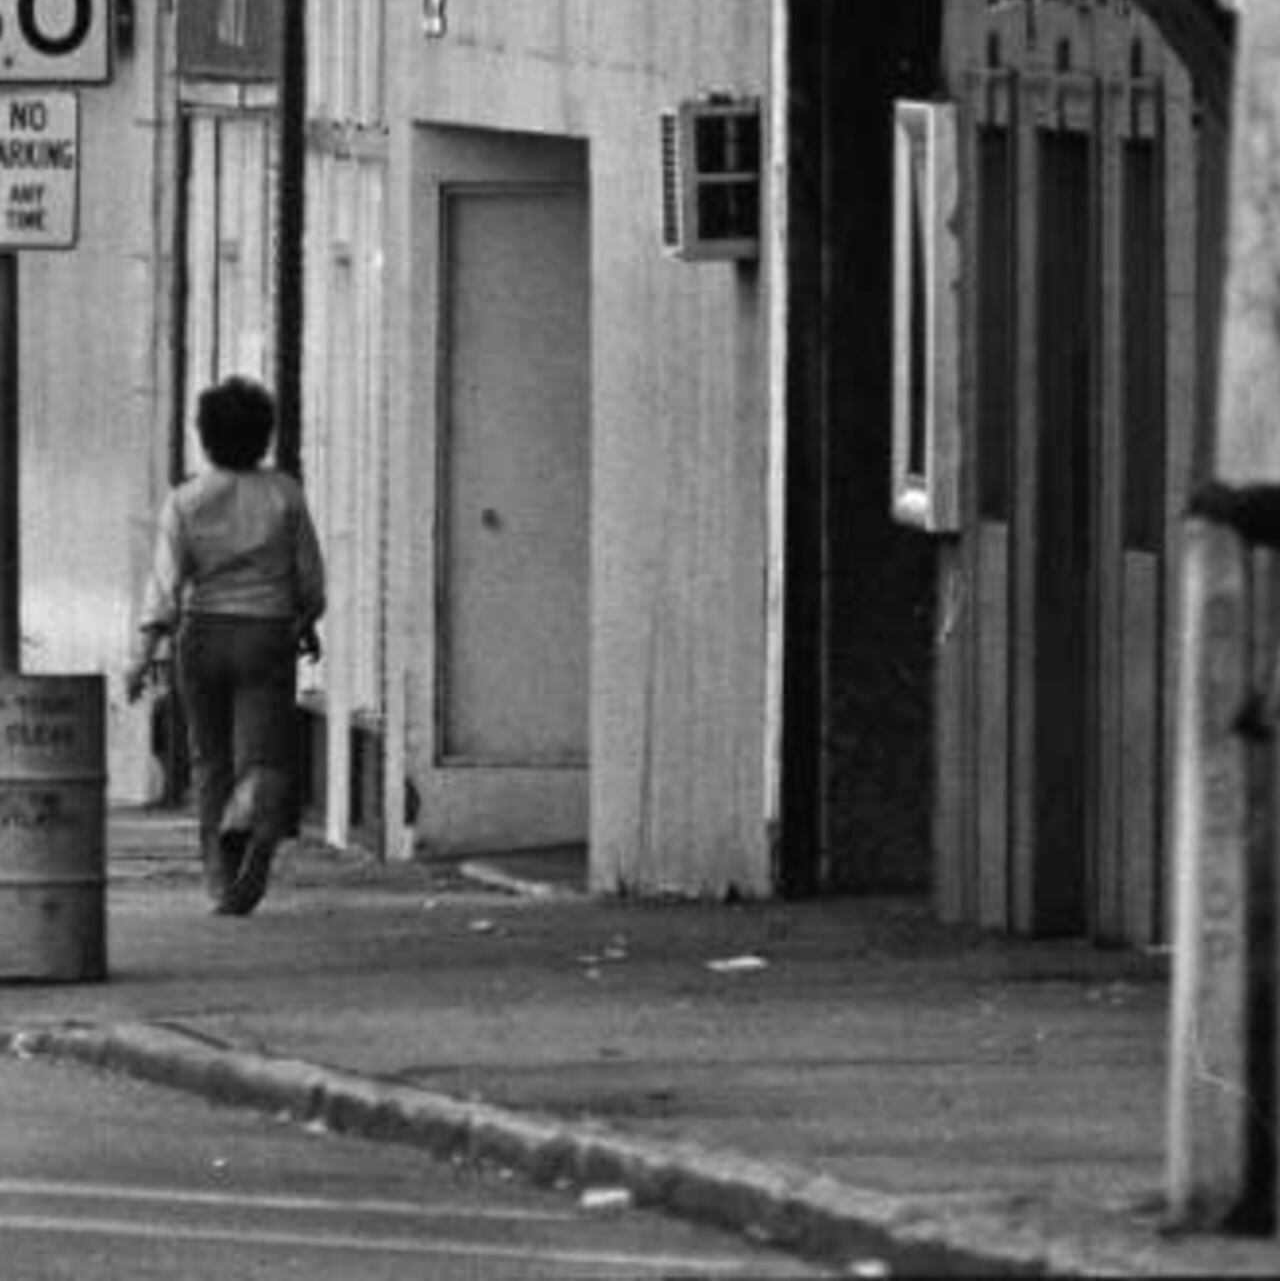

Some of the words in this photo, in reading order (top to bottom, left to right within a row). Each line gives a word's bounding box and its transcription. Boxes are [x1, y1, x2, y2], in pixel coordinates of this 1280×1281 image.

[9, 102, 47, 131] NO
[9, 185, 45, 204] ANY
[6, 211, 46, 232] TIME
